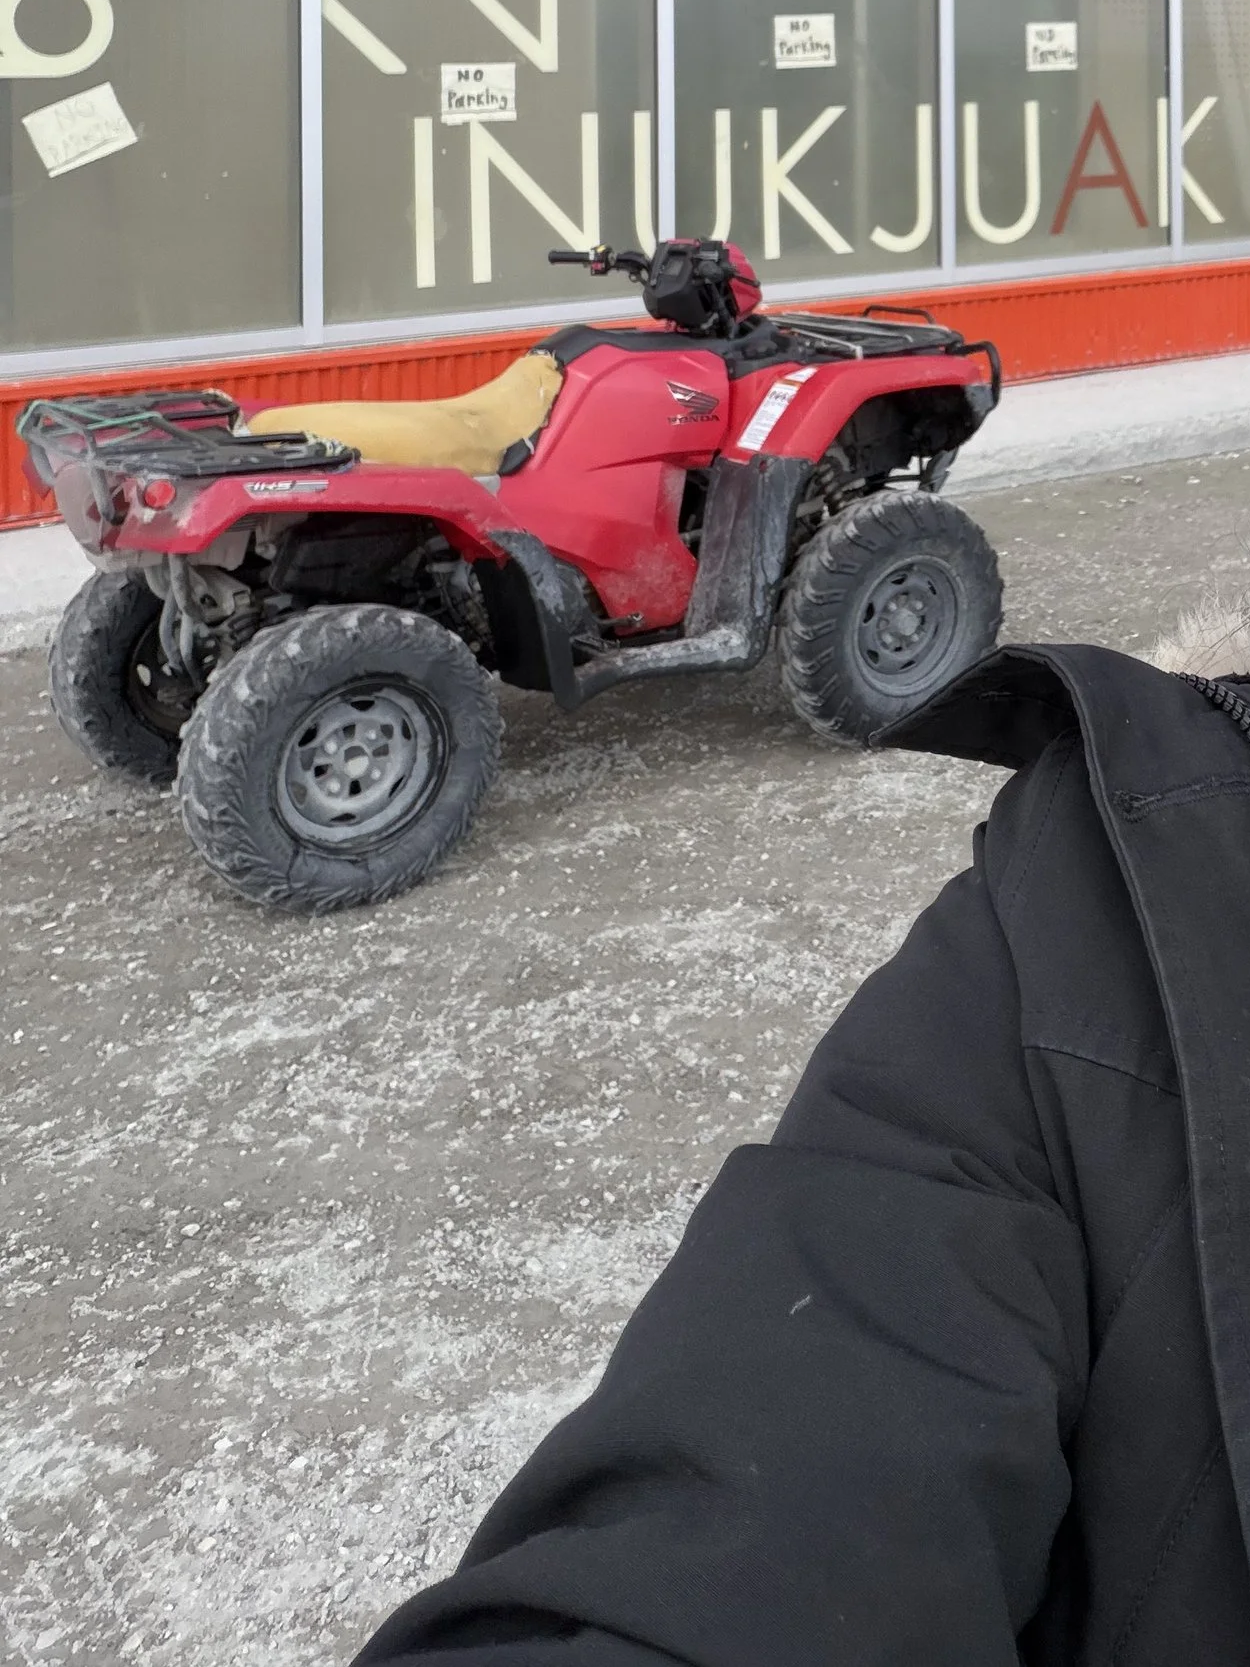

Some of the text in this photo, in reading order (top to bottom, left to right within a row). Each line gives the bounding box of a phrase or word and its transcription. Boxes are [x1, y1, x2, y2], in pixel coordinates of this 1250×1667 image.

[790, 20, 810, 33] NO
[779, 35, 831, 61] Parking
[457, 69, 484, 82] NO
[447, 87, 508, 110] Parking
[413, 96, 1225, 288] INUKJUAK
[667, 414, 721, 426] HONDA
